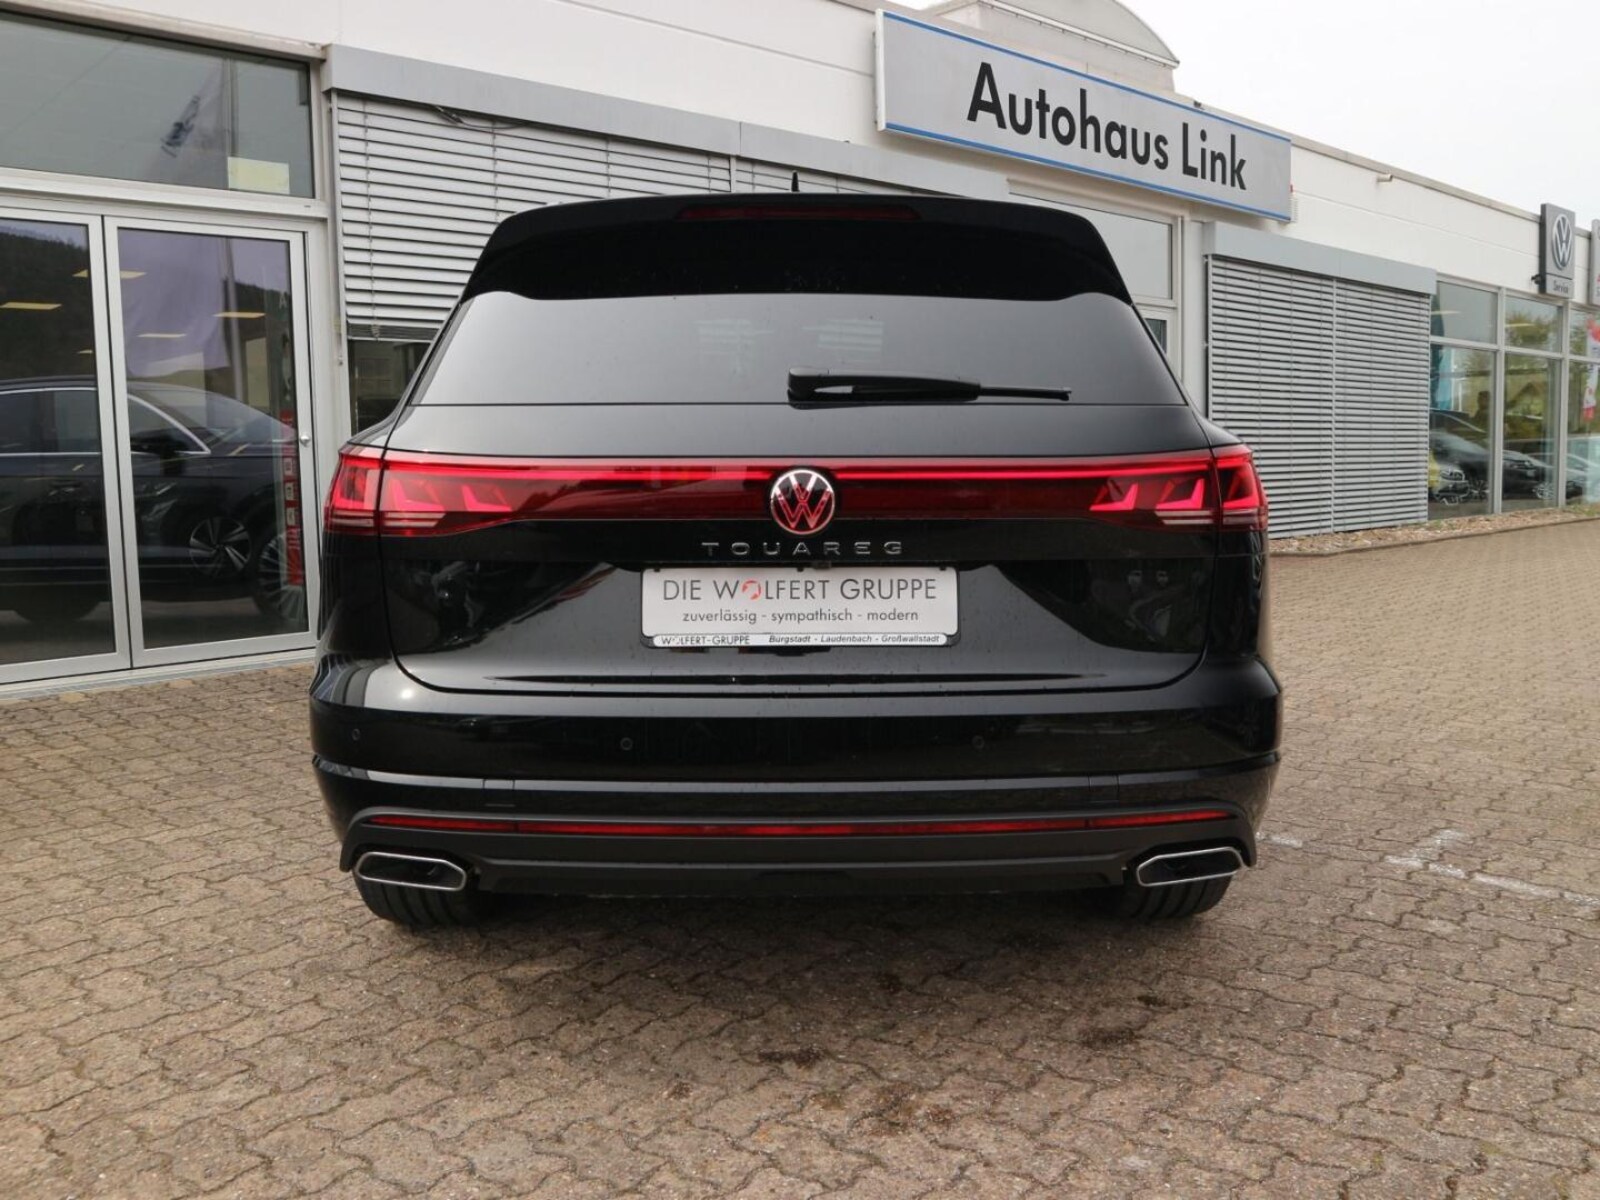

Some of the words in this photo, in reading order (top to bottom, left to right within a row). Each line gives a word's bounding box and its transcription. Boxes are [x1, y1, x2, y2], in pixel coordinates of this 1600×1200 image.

[966, 61, 1169, 170] Autohaus
[1182, 122, 1247, 190] Link
[701, 542, 902, 556] TOUAREG
[663, 580, 702, 600] DIE
[713, 578, 830, 601] WOLFERT
[840, 578, 937, 600] GRUPPE
[682, 608, 757, 624] zuverlässig
[771, 608, 852, 624] sympathisch
[867, 607, 919, 621] modern
[820, 634, 872, 643] Laudenbach
